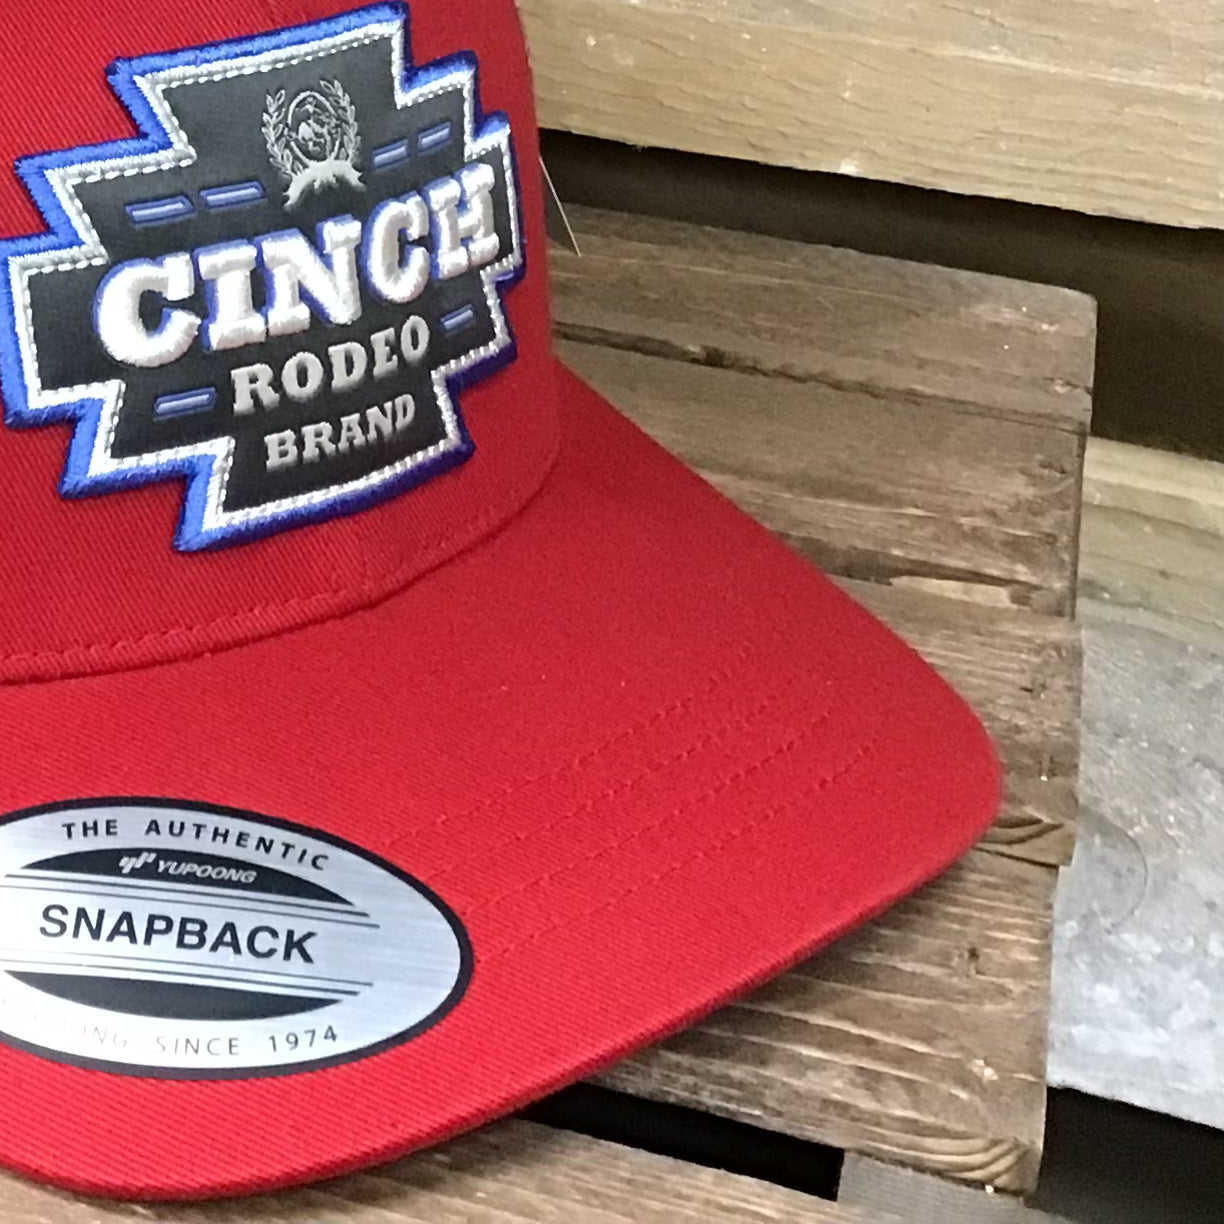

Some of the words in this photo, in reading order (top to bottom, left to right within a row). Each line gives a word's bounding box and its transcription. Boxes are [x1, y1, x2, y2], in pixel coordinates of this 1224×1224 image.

[94, 162, 502, 368] CINCH
[230, 314, 431, 417] RODEO
[263, 393, 417, 471] BRAND
[61, 818, 118, 841] THE
[144, 818, 331, 872] AUTHENTIC
[156, 859, 258, 884] YUPOONG
[38, 903, 319, 965] SNAPBACK
[155, 1035, 241, 1057] SINCE
[267, 1024, 339, 1054] 1974
